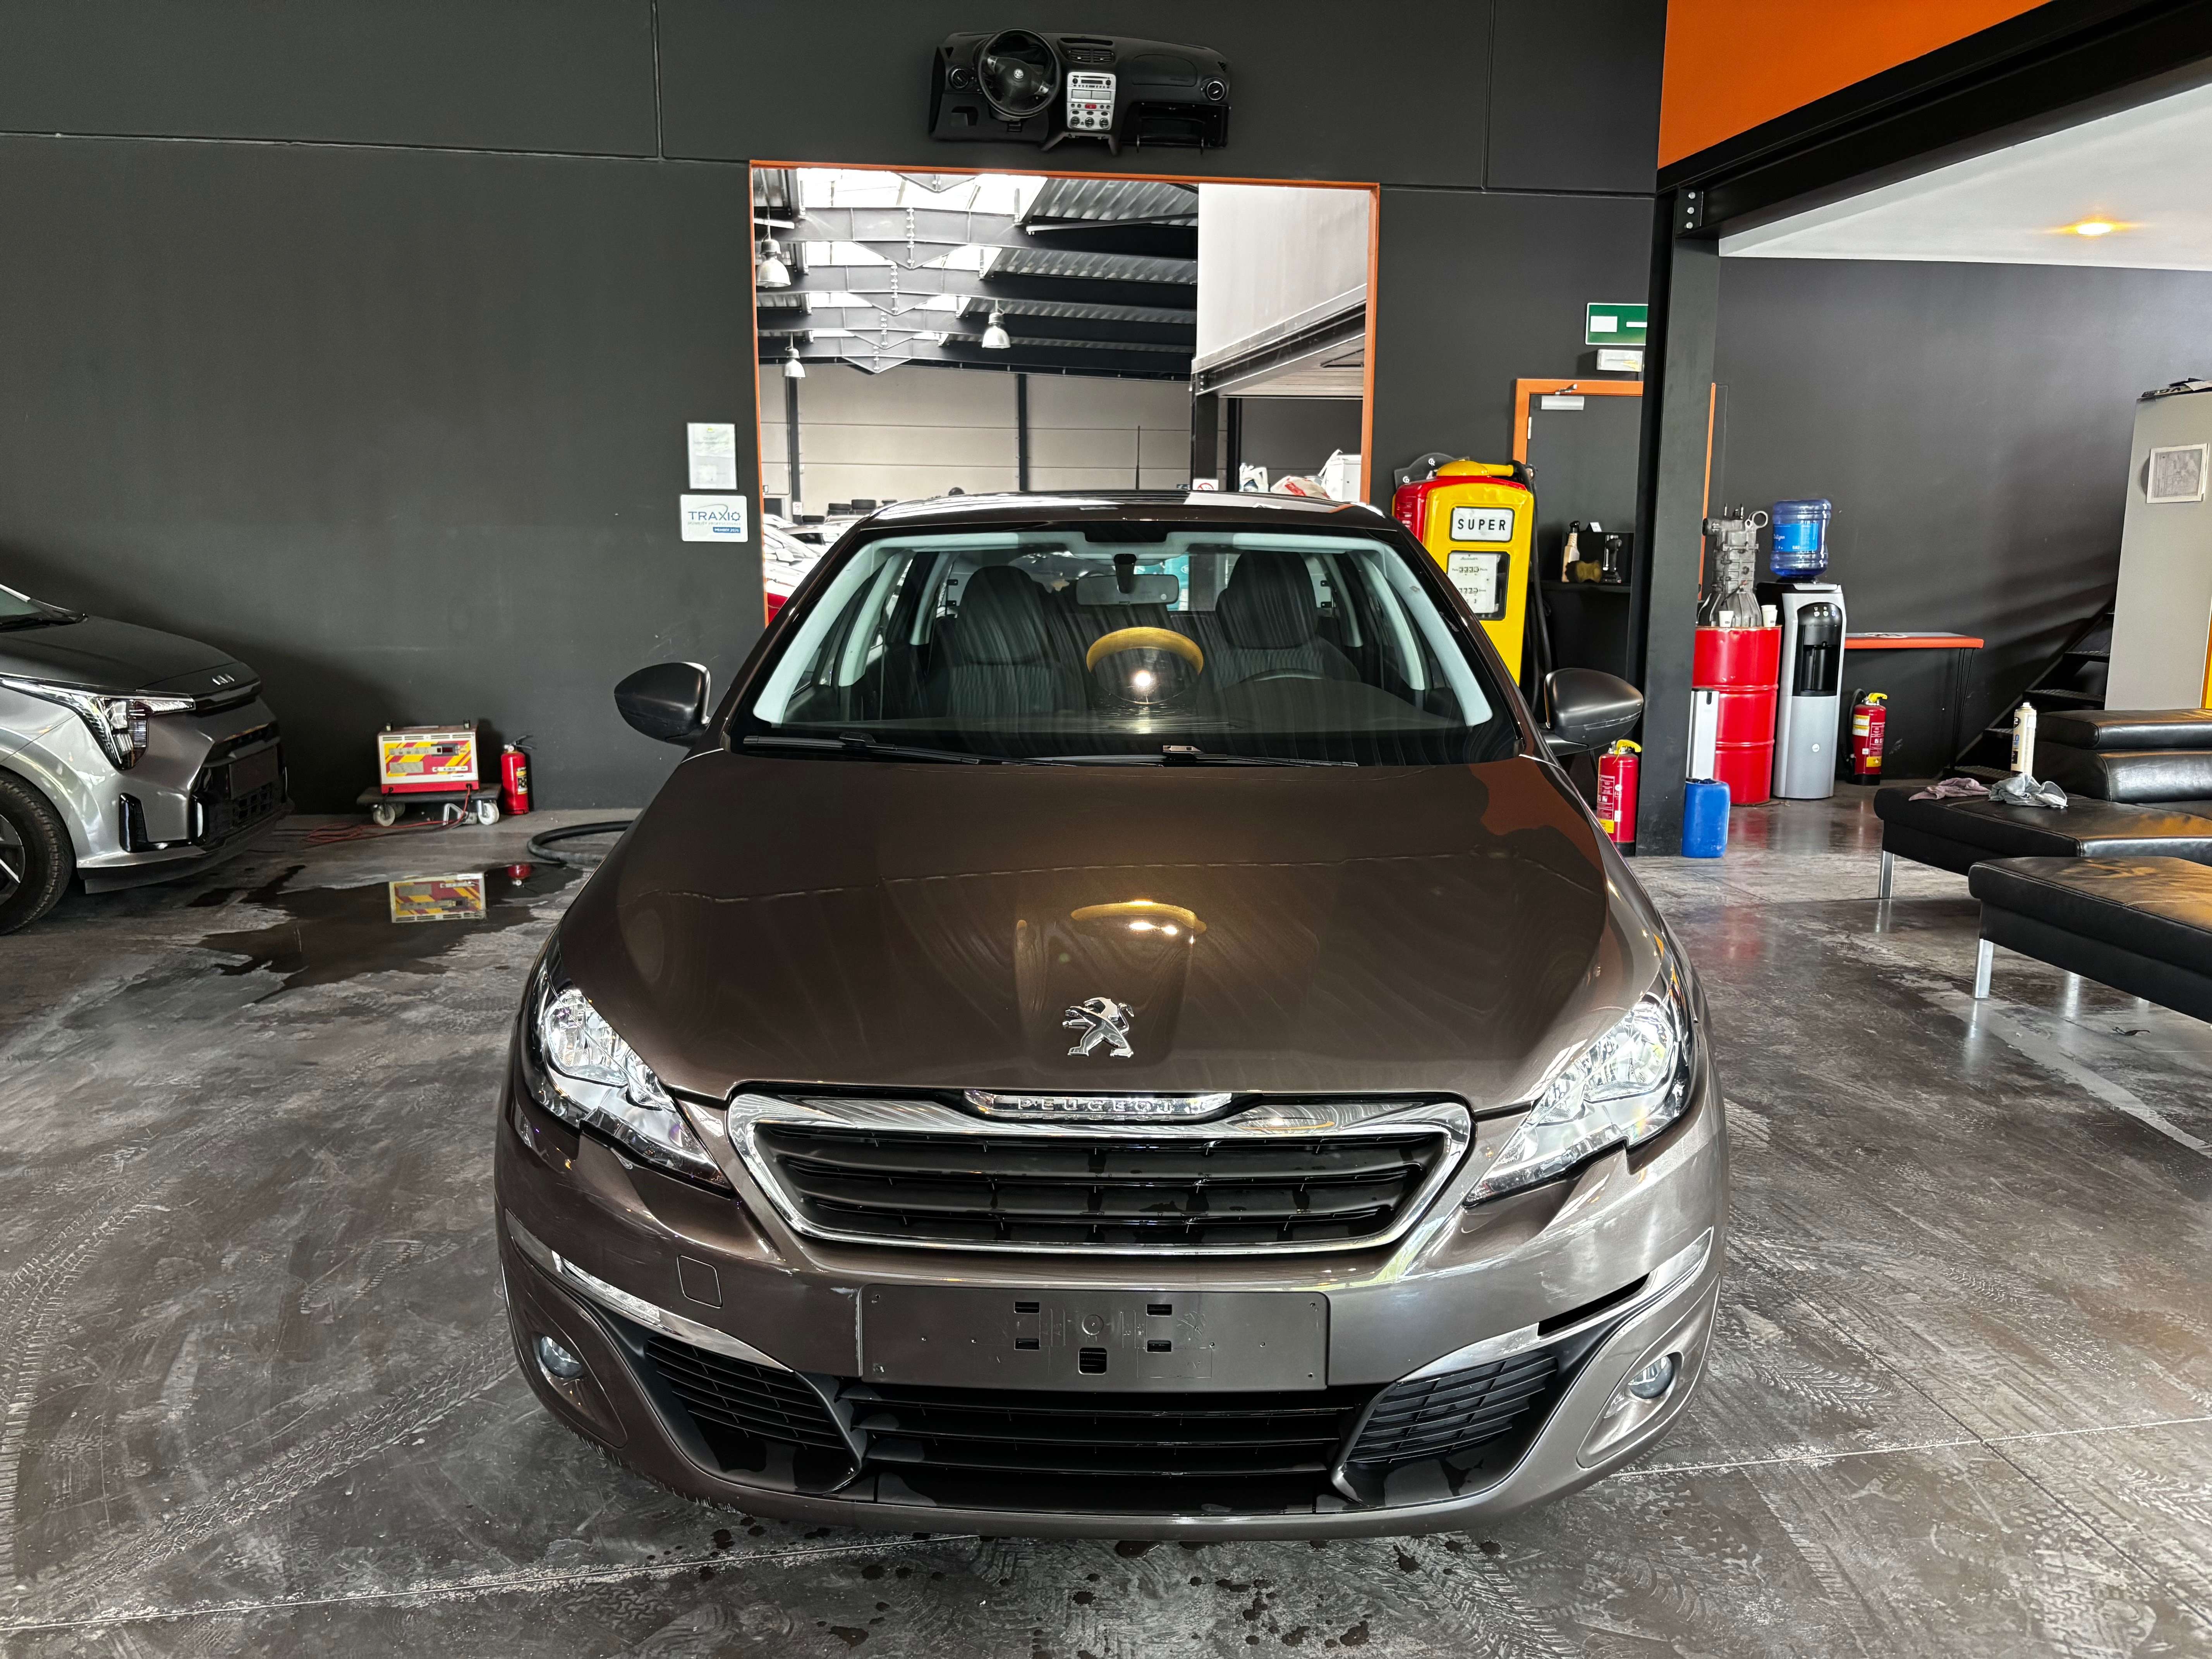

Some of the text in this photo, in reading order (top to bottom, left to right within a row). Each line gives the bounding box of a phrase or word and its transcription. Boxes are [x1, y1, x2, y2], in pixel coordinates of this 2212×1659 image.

[688, 511, 741, 521] TRAXIO
[1458, 519, 1506, 531] SUPER
[1017, 1097, 1173, 1114] PEUGEOT
